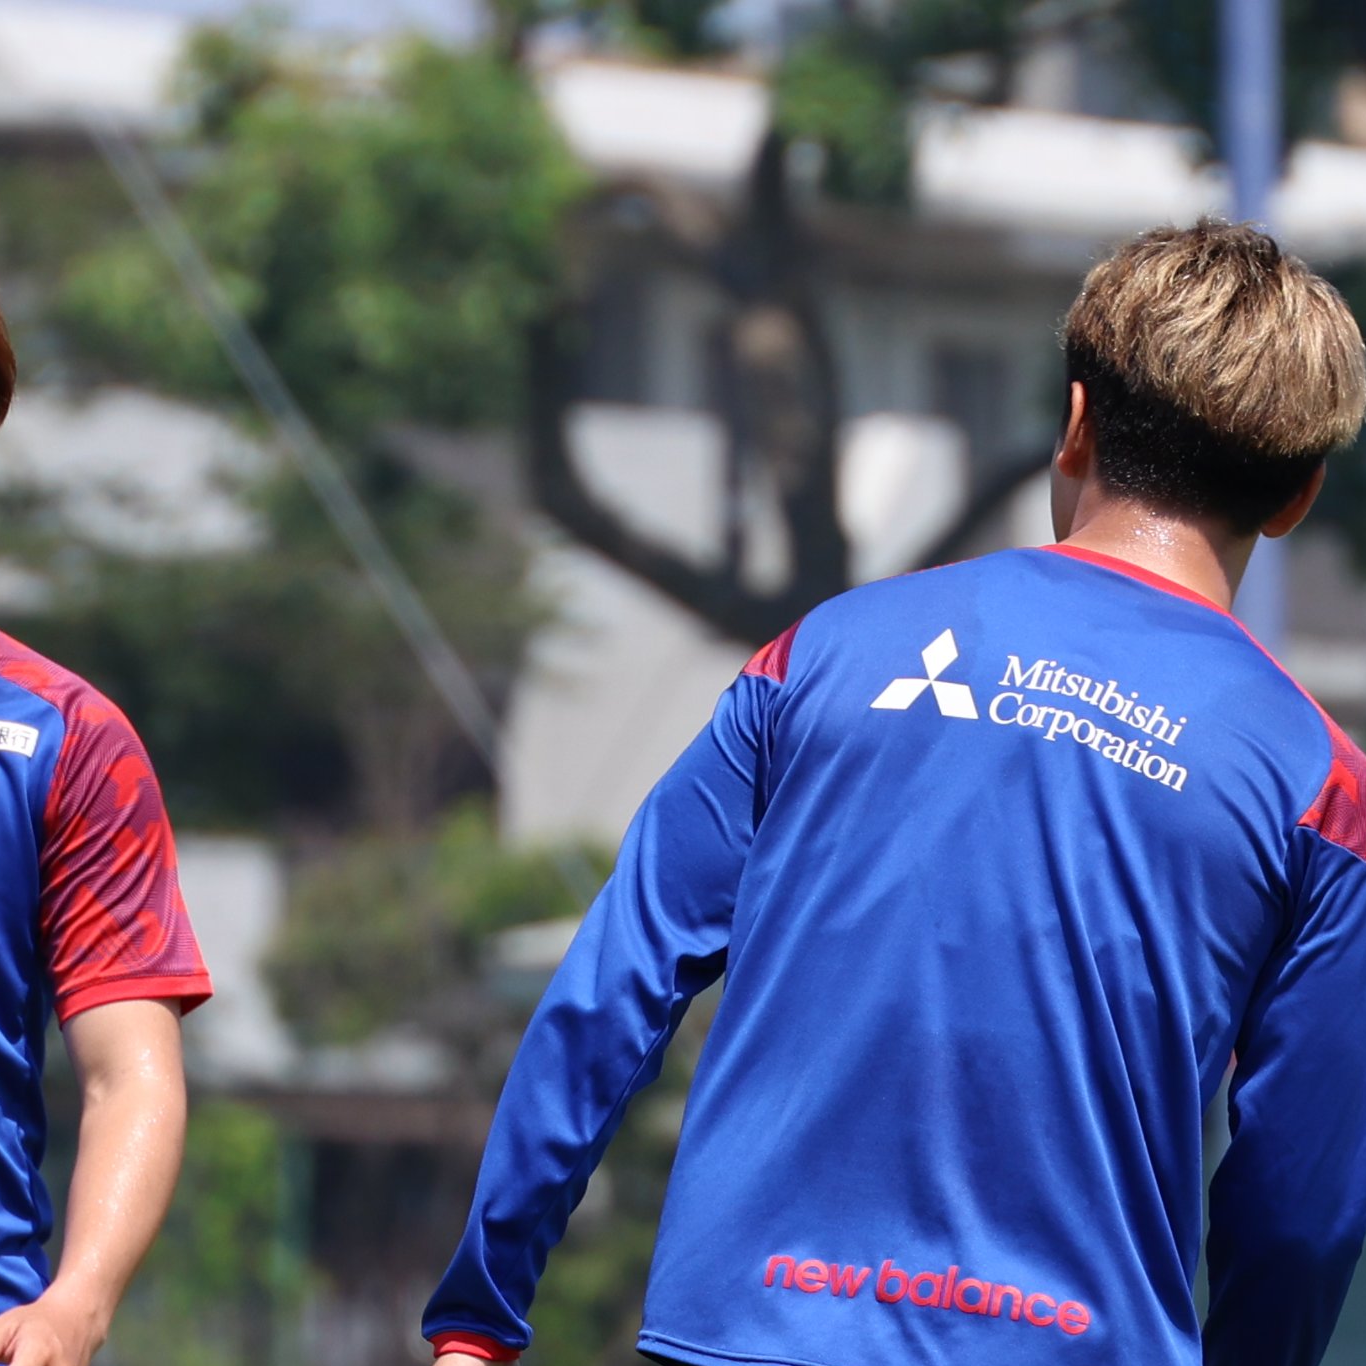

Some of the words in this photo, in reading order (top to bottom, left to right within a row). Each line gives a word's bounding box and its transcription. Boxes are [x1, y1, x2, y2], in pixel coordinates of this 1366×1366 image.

[989, 692, 1187, 791] Corporation
[998, 655, 1187, 746] Mitsubishi
[763, 1254, 871, 1299] new
[875, 1259, 1091, 1335] balance
